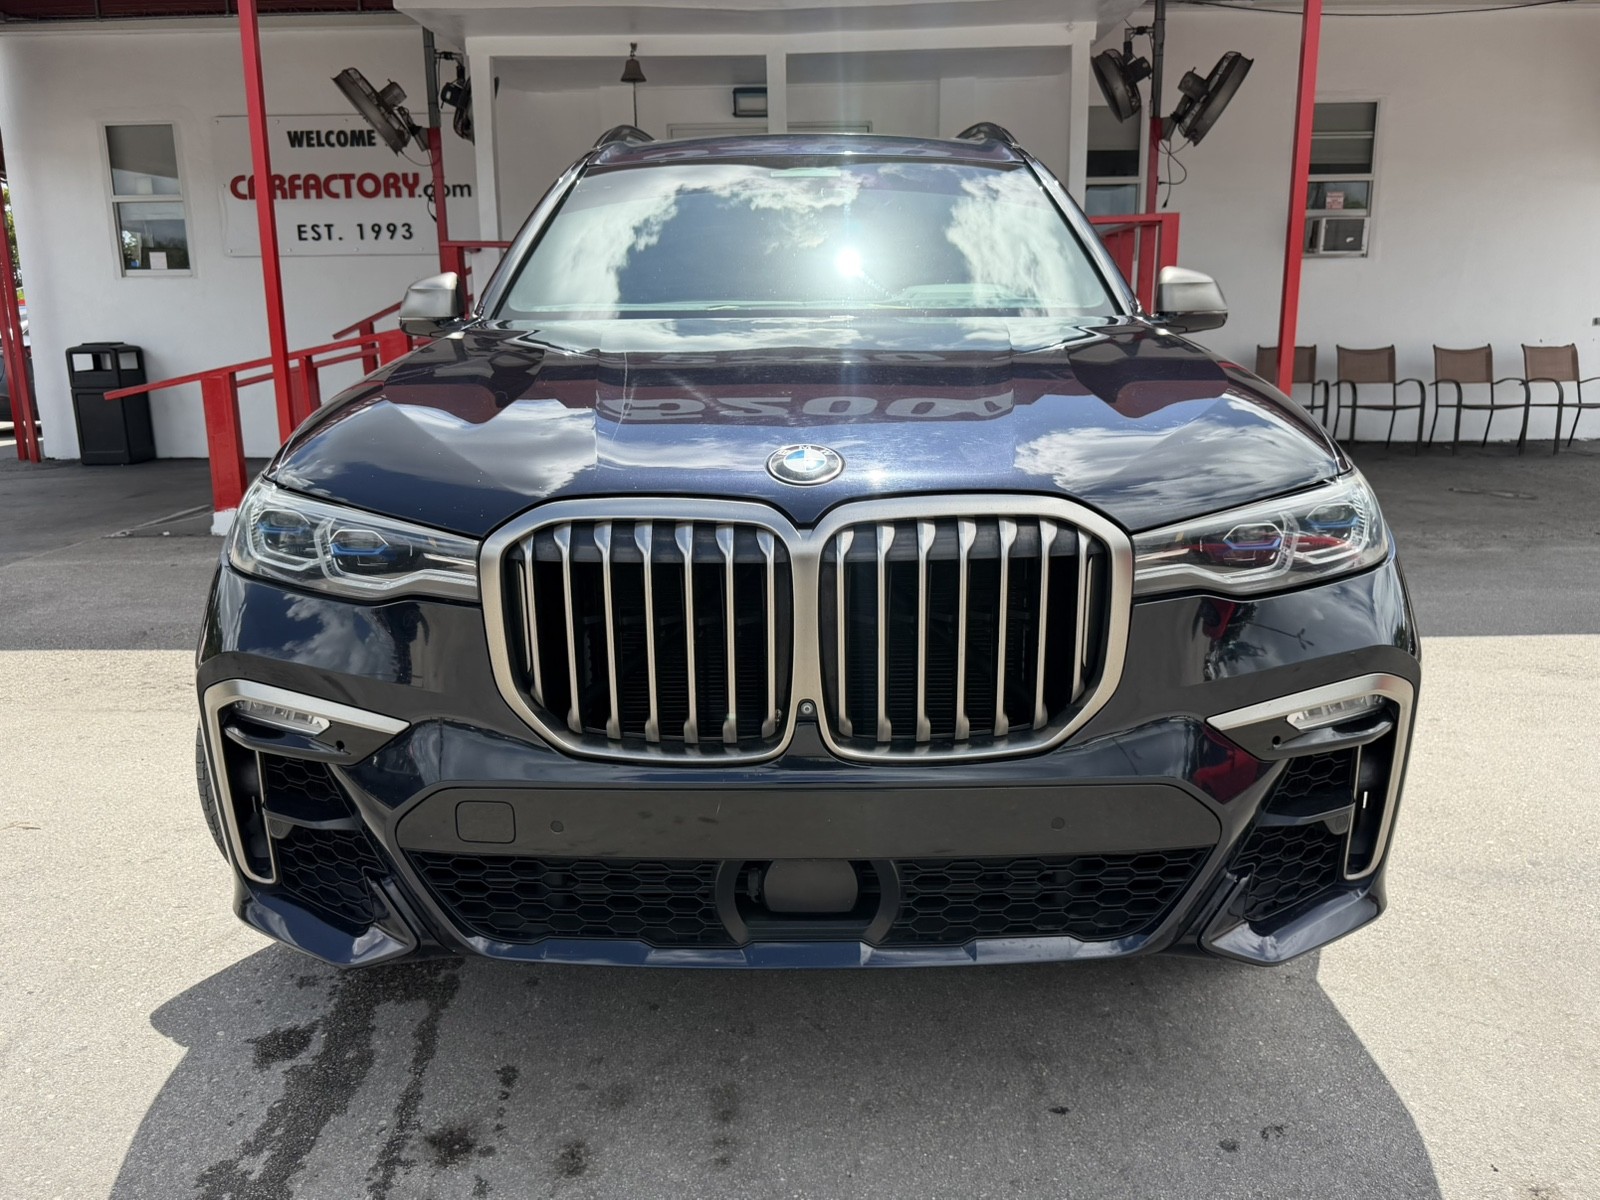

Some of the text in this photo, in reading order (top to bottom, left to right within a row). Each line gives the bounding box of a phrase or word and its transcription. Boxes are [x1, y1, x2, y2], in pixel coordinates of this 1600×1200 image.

[287, 129, 376, 148] WELCOME
[297, 222, 414, 241] EST. 1993
